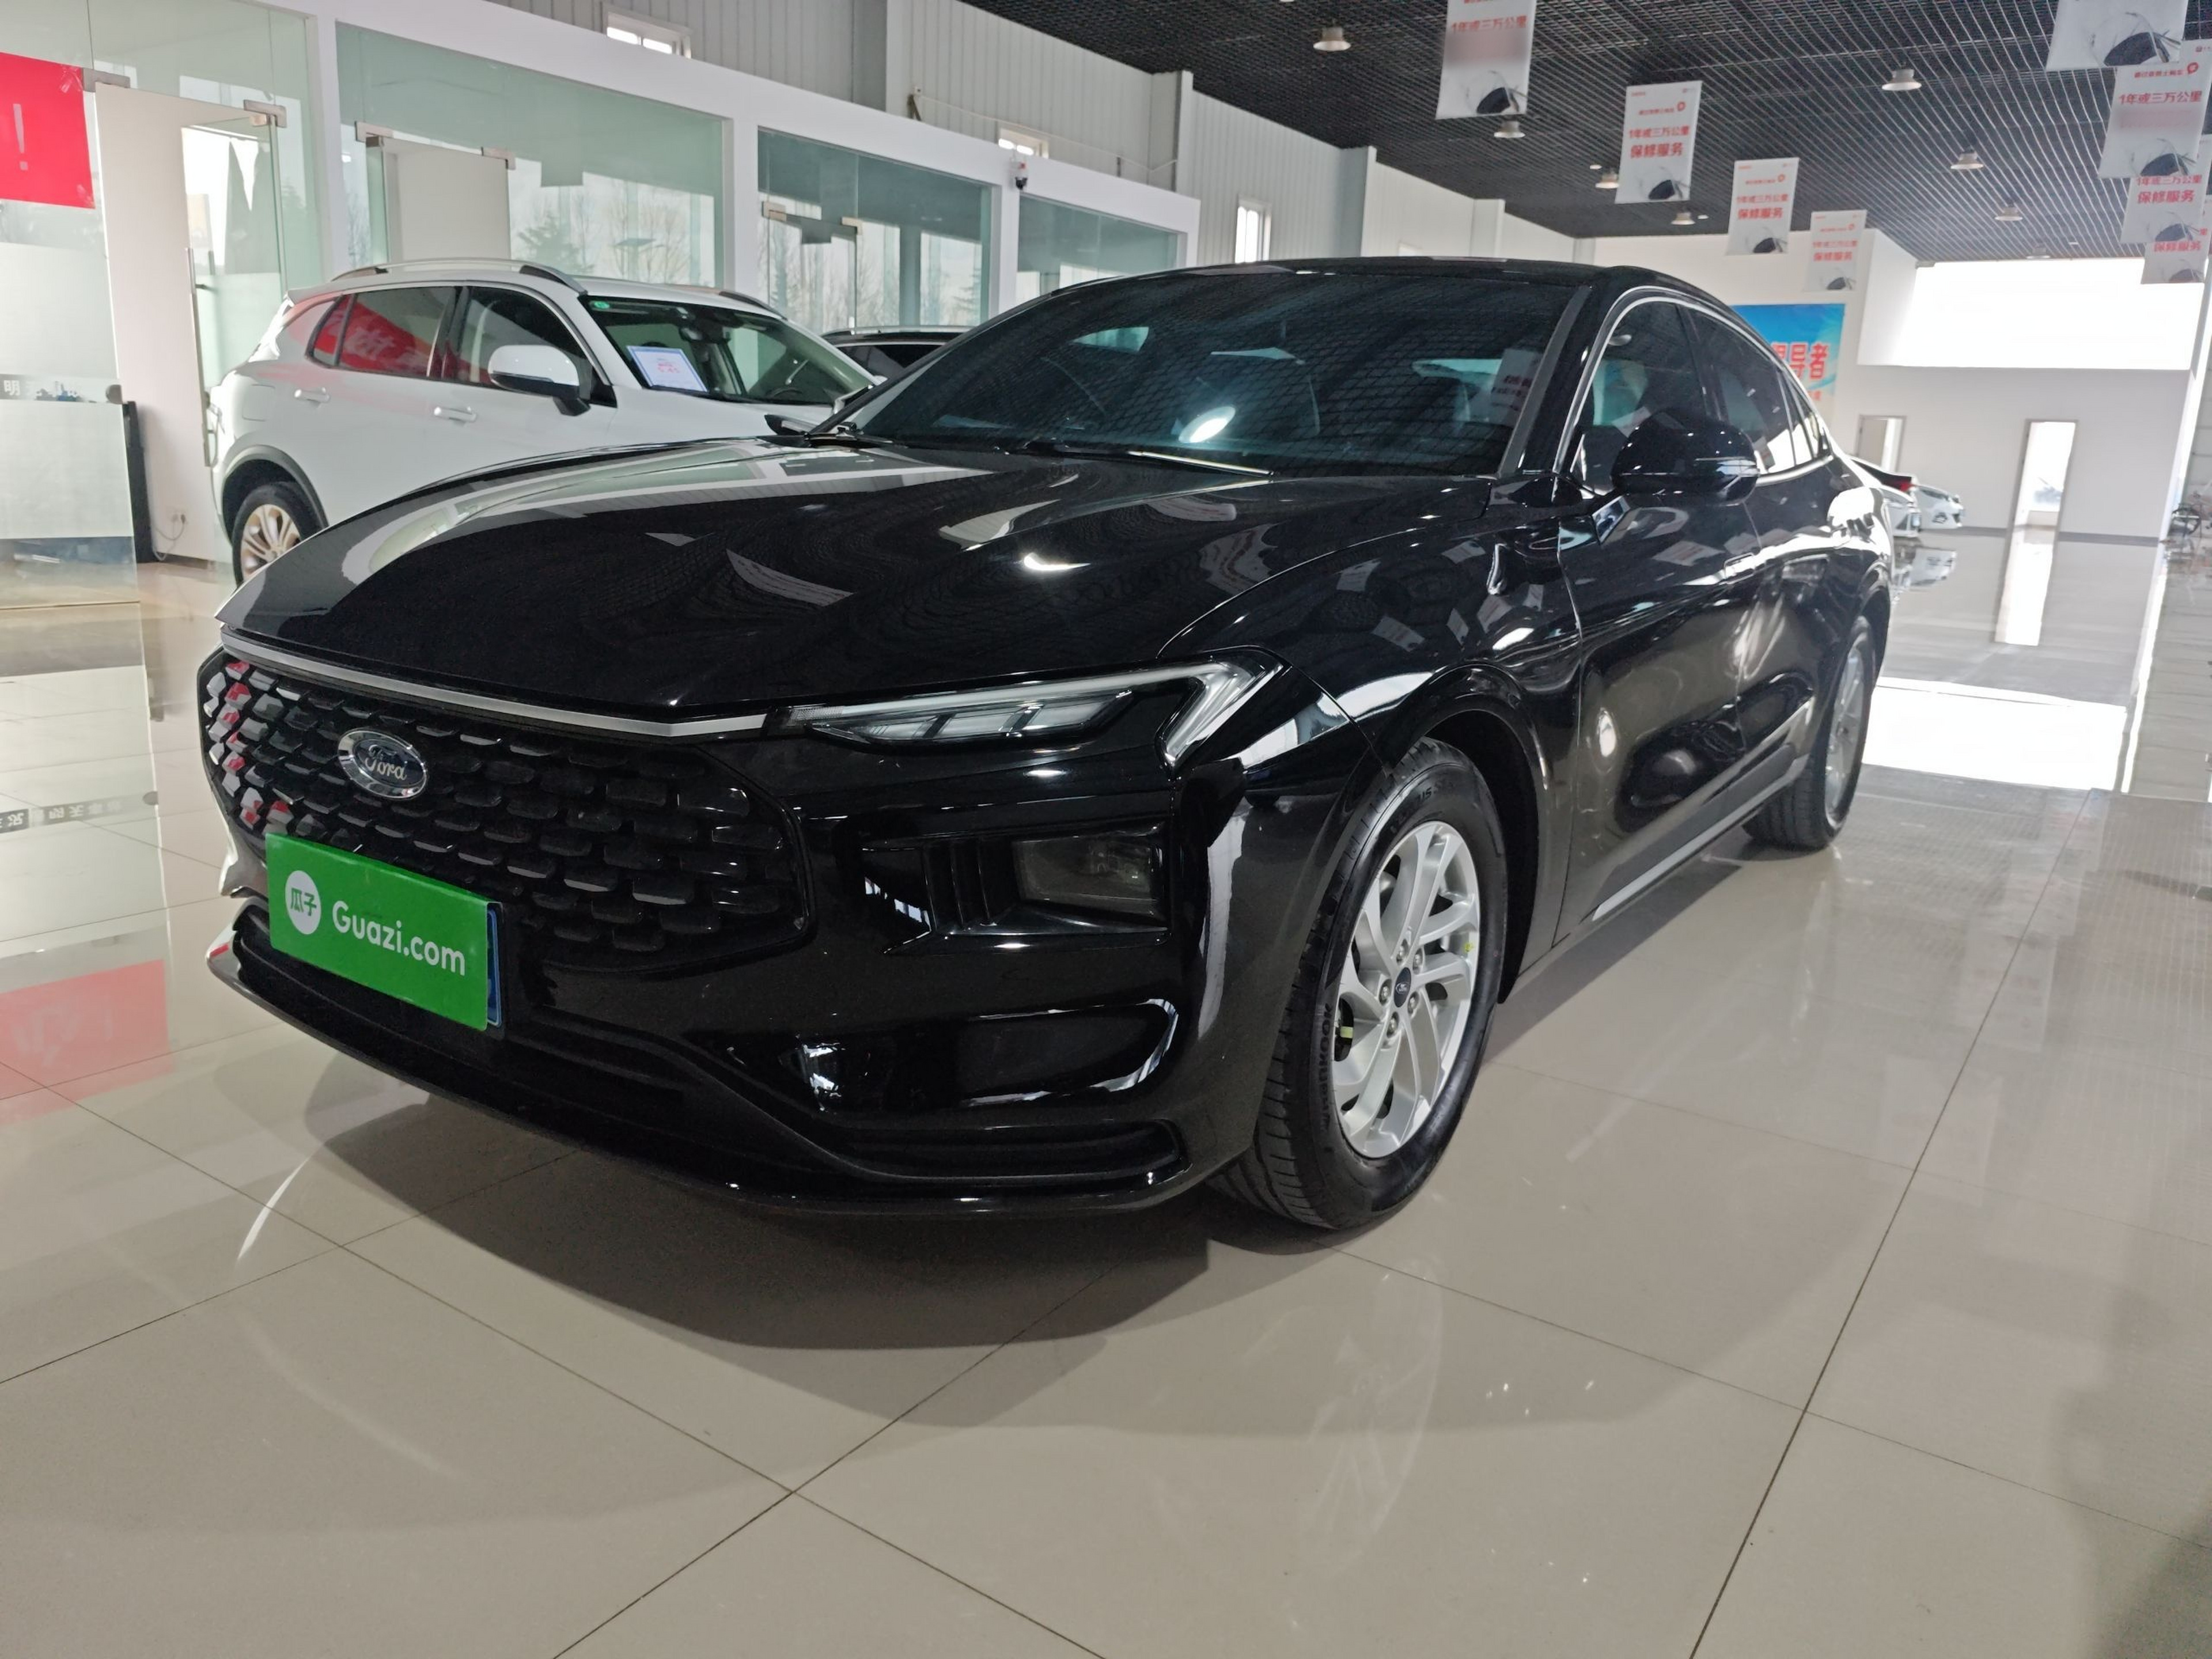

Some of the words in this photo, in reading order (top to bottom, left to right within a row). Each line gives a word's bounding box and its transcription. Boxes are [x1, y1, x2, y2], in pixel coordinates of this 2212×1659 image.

[2120, 90, 2202, 104] 1年或三万公里
[1631, 142, 1683, 158] 保修服务
[2138, 190, 2194, 203] 保修服务
[1738, 208, 1783, 219] 保修服务
[365, 744, 407, 781] Ford
[291, 888, 317, 916] 瓜子
[332, 900, 465, 976] Guazi.com
